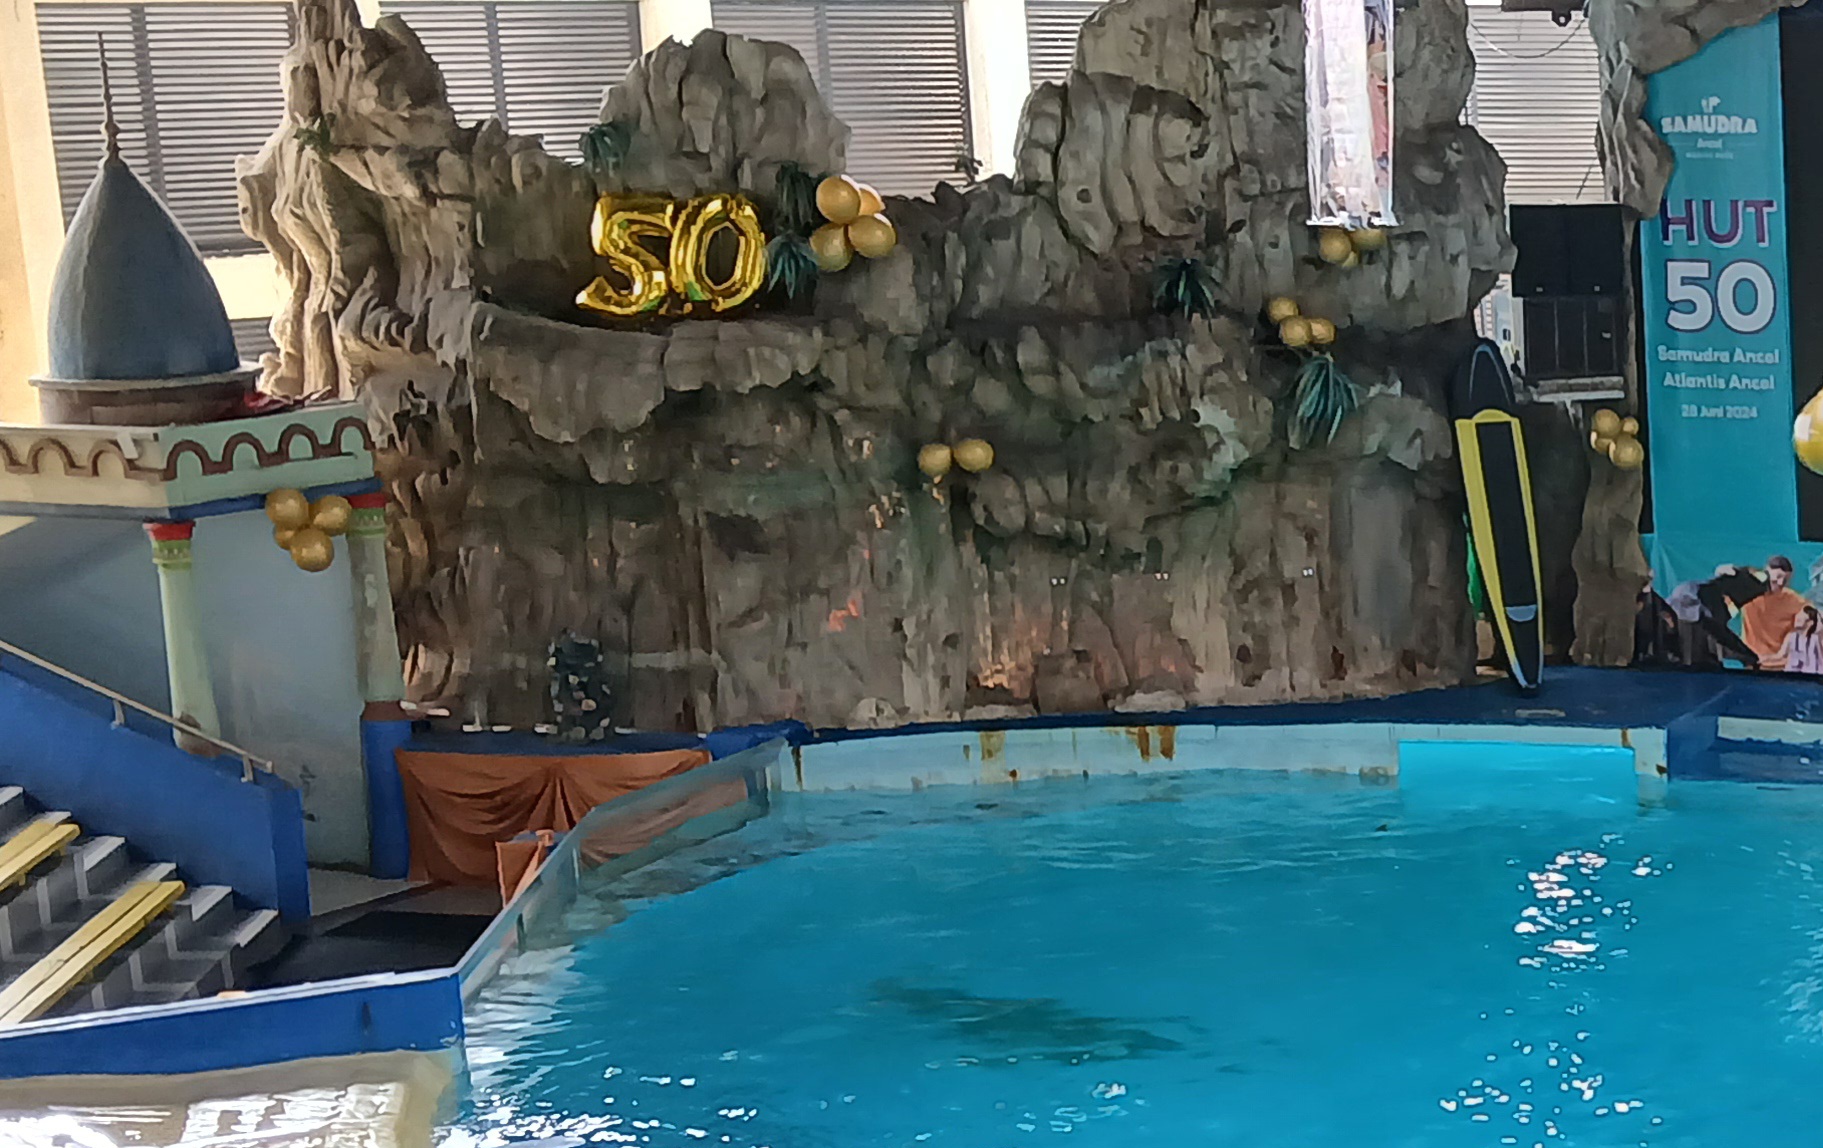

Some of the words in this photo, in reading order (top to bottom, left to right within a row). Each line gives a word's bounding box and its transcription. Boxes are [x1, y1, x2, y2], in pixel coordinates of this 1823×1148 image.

[1660, 114, 1758, 134] SAMUDRA
[1660, 198, 1778, 249] HUT
[574, 192, 767, 317] 50
[1665, 258, 1777, 335] 50
[1656, 344, 1731, 364] Samudra
[1732, 347, 1780, 365] Ancol
[1663, 371, 1727, 390] Atlantis
[1728, 373, 1776, 391] Ancol
